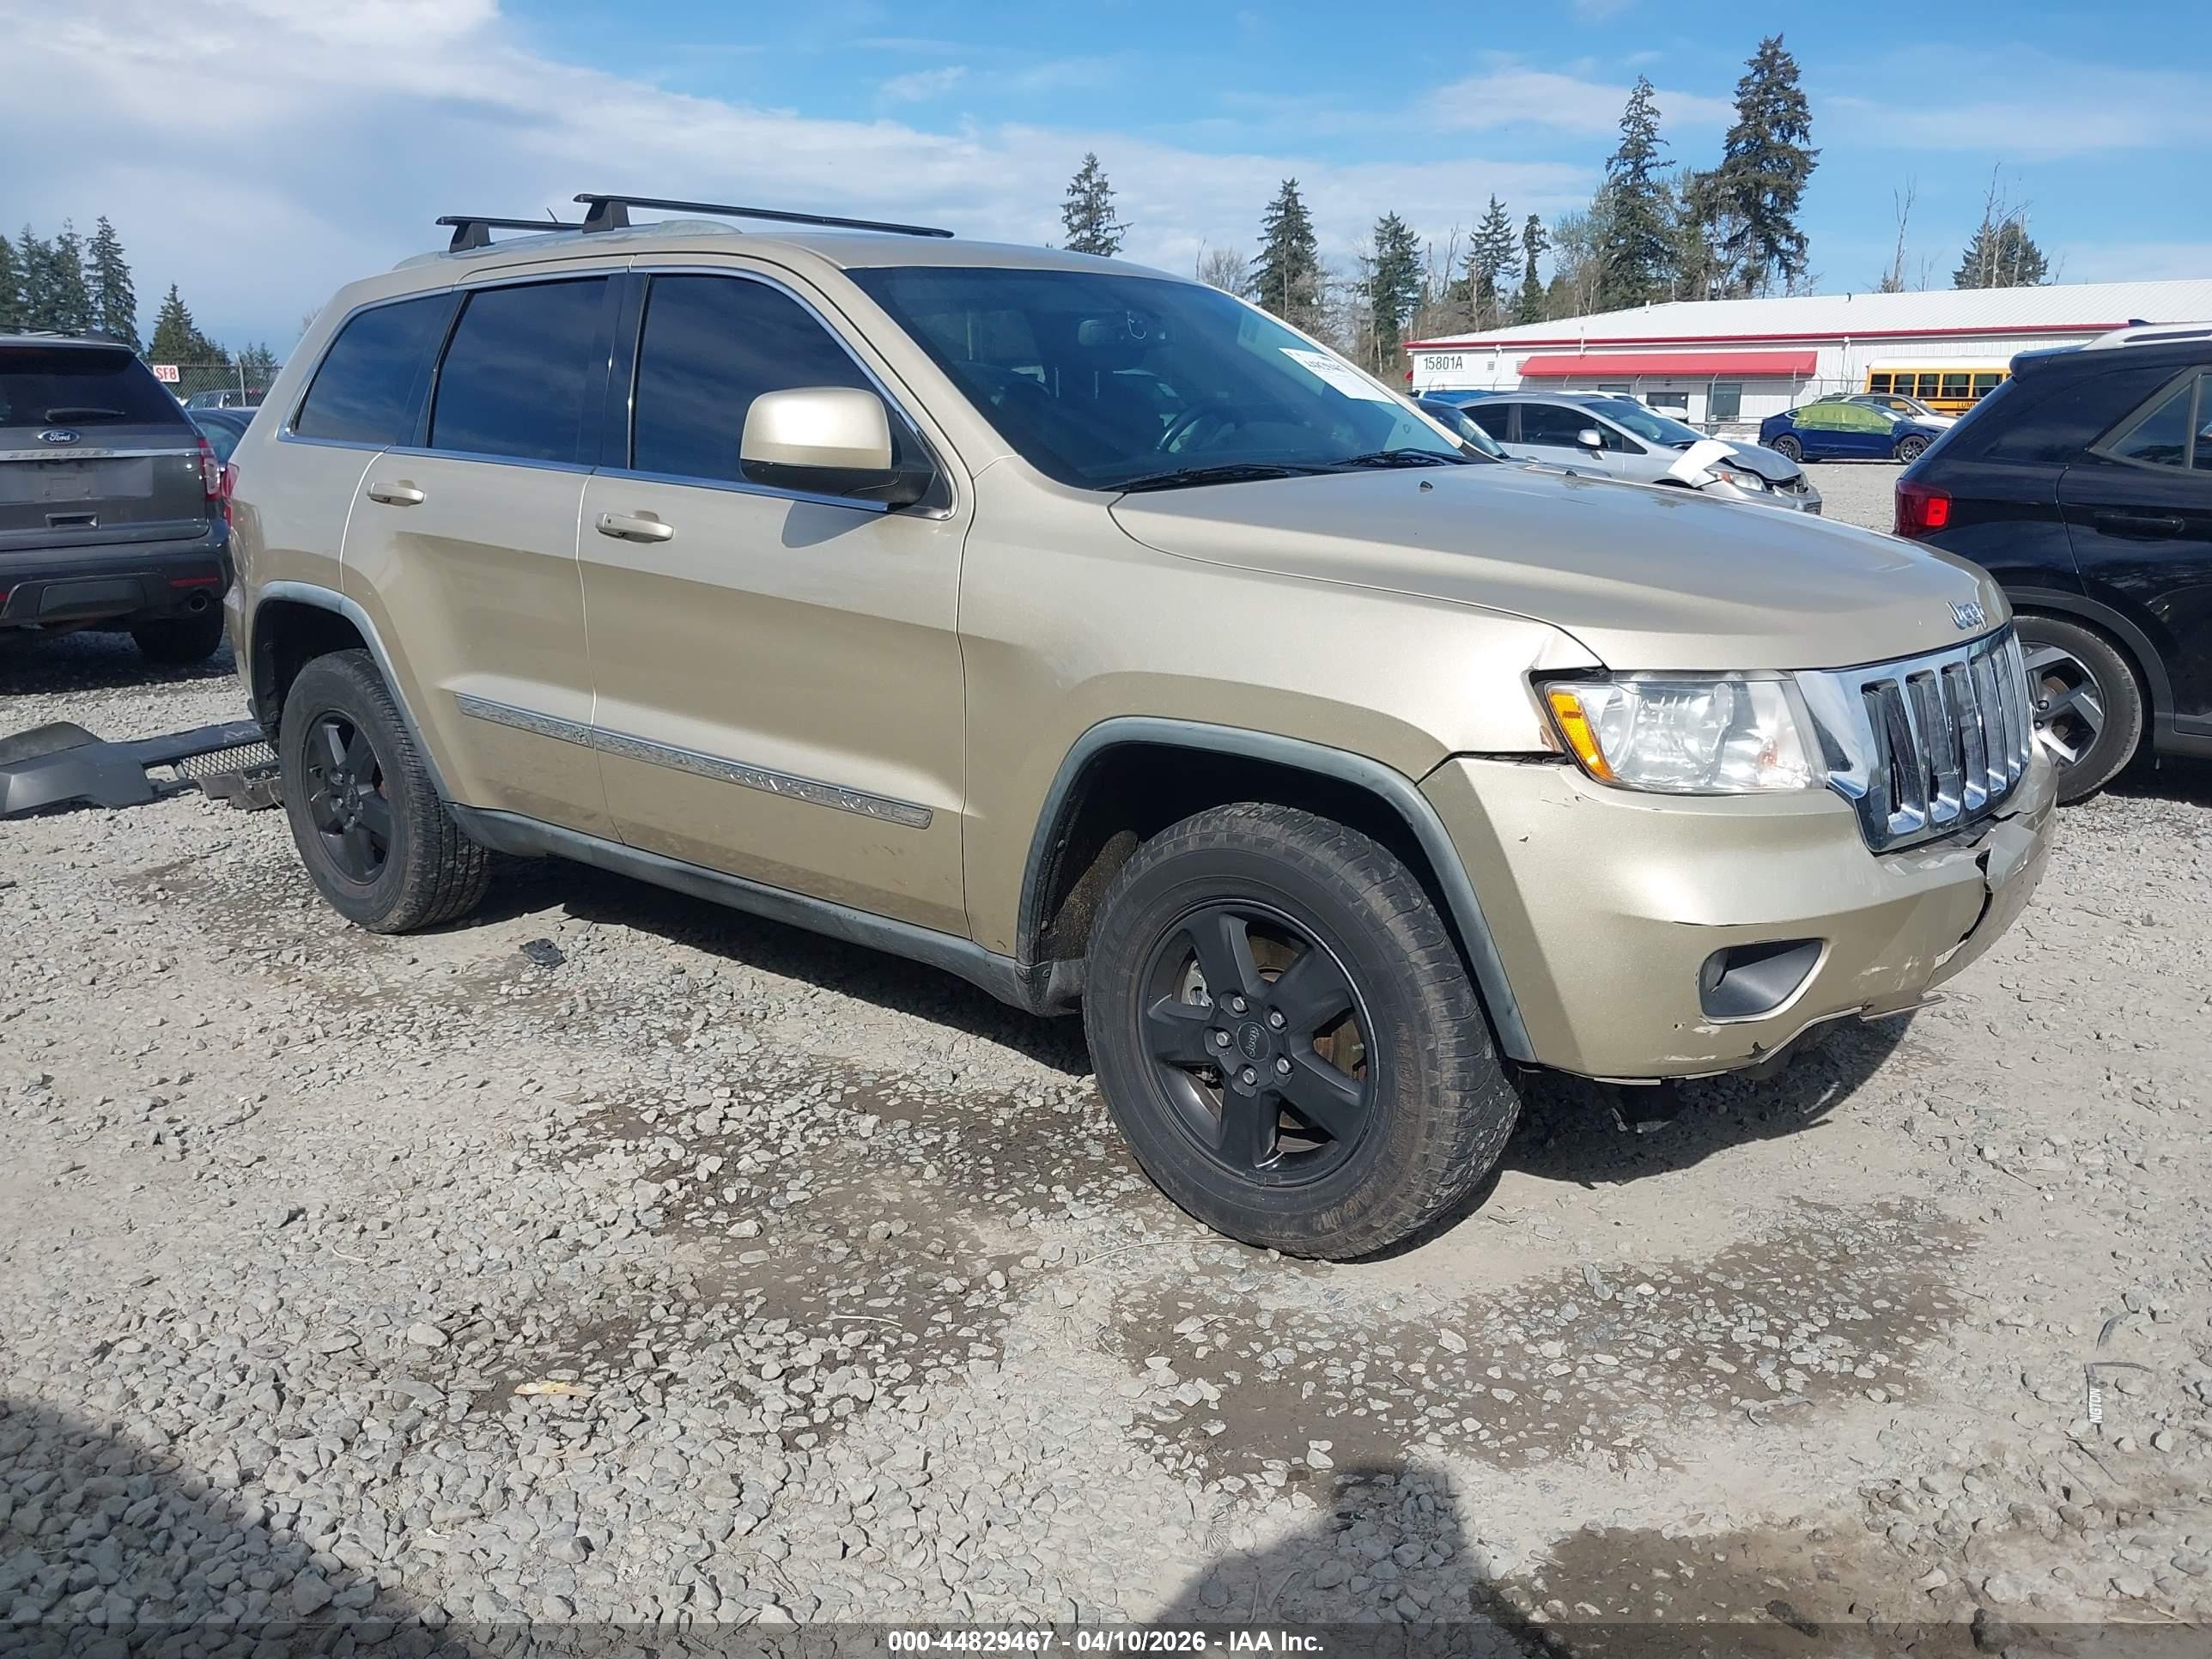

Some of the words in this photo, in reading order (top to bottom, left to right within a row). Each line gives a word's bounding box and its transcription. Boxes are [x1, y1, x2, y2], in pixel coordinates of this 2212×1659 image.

[155, 367, 177, 380] SF8
[1423, 356, 1463, 371] 15801A
[49, 432, 71, 441] Ford
[1945, 600, 1988, 629] Jeep
[728, 767, 798, 793] GRAND
[799, 785, 902, 818] CHEROKEE
[1245, 1026, 1260, 1057] Jeep
[2088, 1388, 2103, 1423] NGTON
